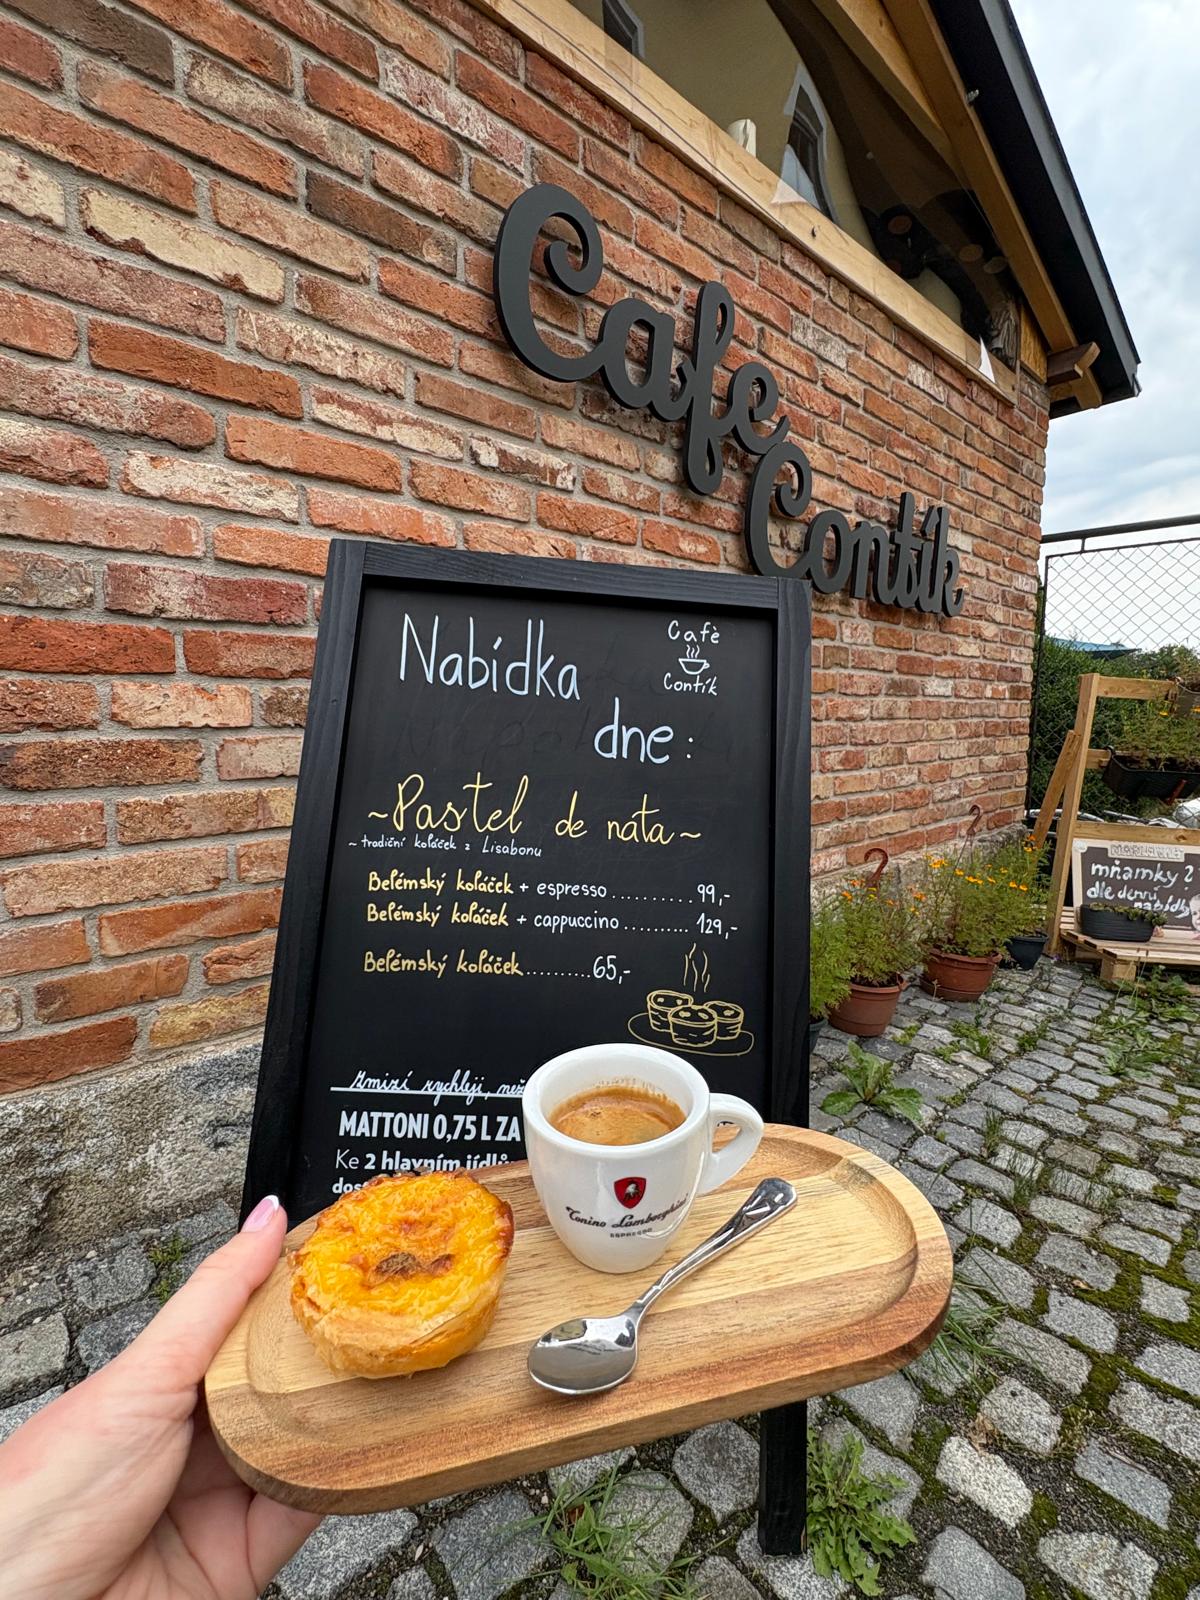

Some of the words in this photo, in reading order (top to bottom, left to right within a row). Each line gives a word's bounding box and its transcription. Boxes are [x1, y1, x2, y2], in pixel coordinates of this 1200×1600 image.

[493, 183, 789, 496] Cafe
[400, 613, 580, 700] Nabídka
[555, 791, 587, 838] de
[482, 835, 541, 856] Lisabonu
[369, 867, 446, 896] Belémský
[457, 869, 514, 894] koláček
[537, 883, 606, 900] espresso
[1087, 881, 1115, 900] dle
[368, 902, 441, 927] Belémský
[451, 902, 508, 926] koláček
[534, 911, 619, 933] cappuccino
[364, 949, 447, 978] Belémský
[339, 1111, 429, 1138] MATTONI
[433, 1114, 476, 1142] 0,75
[481, 1116, 491, 1140] L
[495, 1116, 520, 1141] ZA
[336, 1149, 359, 1169] Ke
[364, 1154, 375, 1169] 2
[565, 1206, 607, 1228] Tonino
